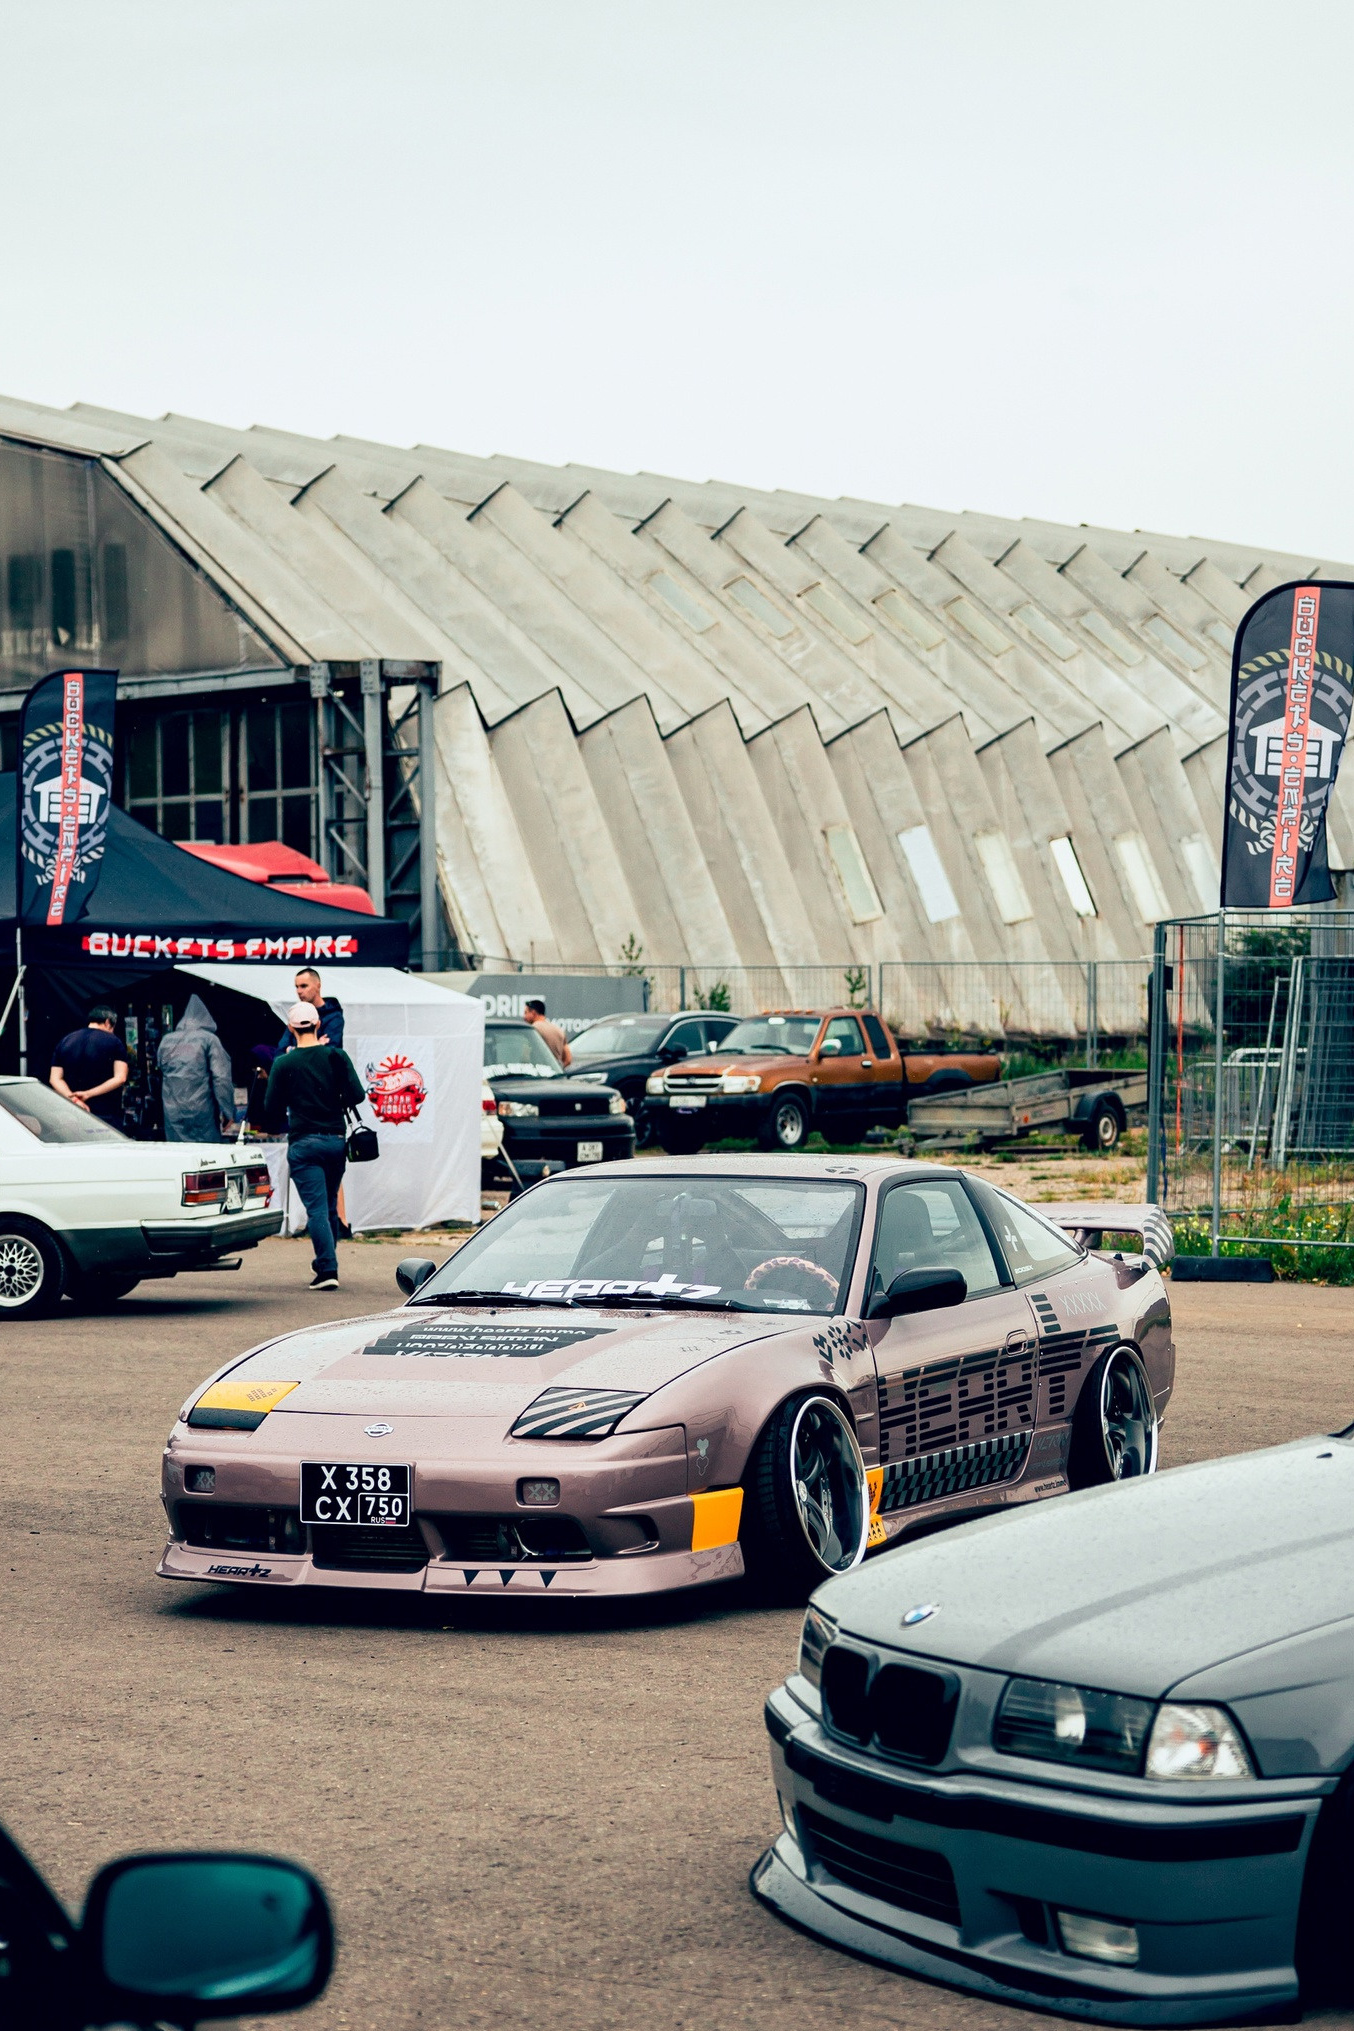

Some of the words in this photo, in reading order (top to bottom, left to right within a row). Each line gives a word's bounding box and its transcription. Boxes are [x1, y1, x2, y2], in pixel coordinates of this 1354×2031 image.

[1285, 595, 1316, 745] BUCKETS
[62, 680, 81, 805] BUCKETS
[1274, 765, 1302, 897] EMPIRE
[50, 814, 76, 918] EMPIRE
[88, 931, 234, 960] BUCKETS
[245, 934, 352, 960] EMPIRE
[315, 1495, 352, 1521] CX
[365, 1496, 402, 1517] 750
[320, 1465, 337, 1490] X
[345, 1466, 391, 1491] 358
[370, 1516, 386, 1524] RUS
